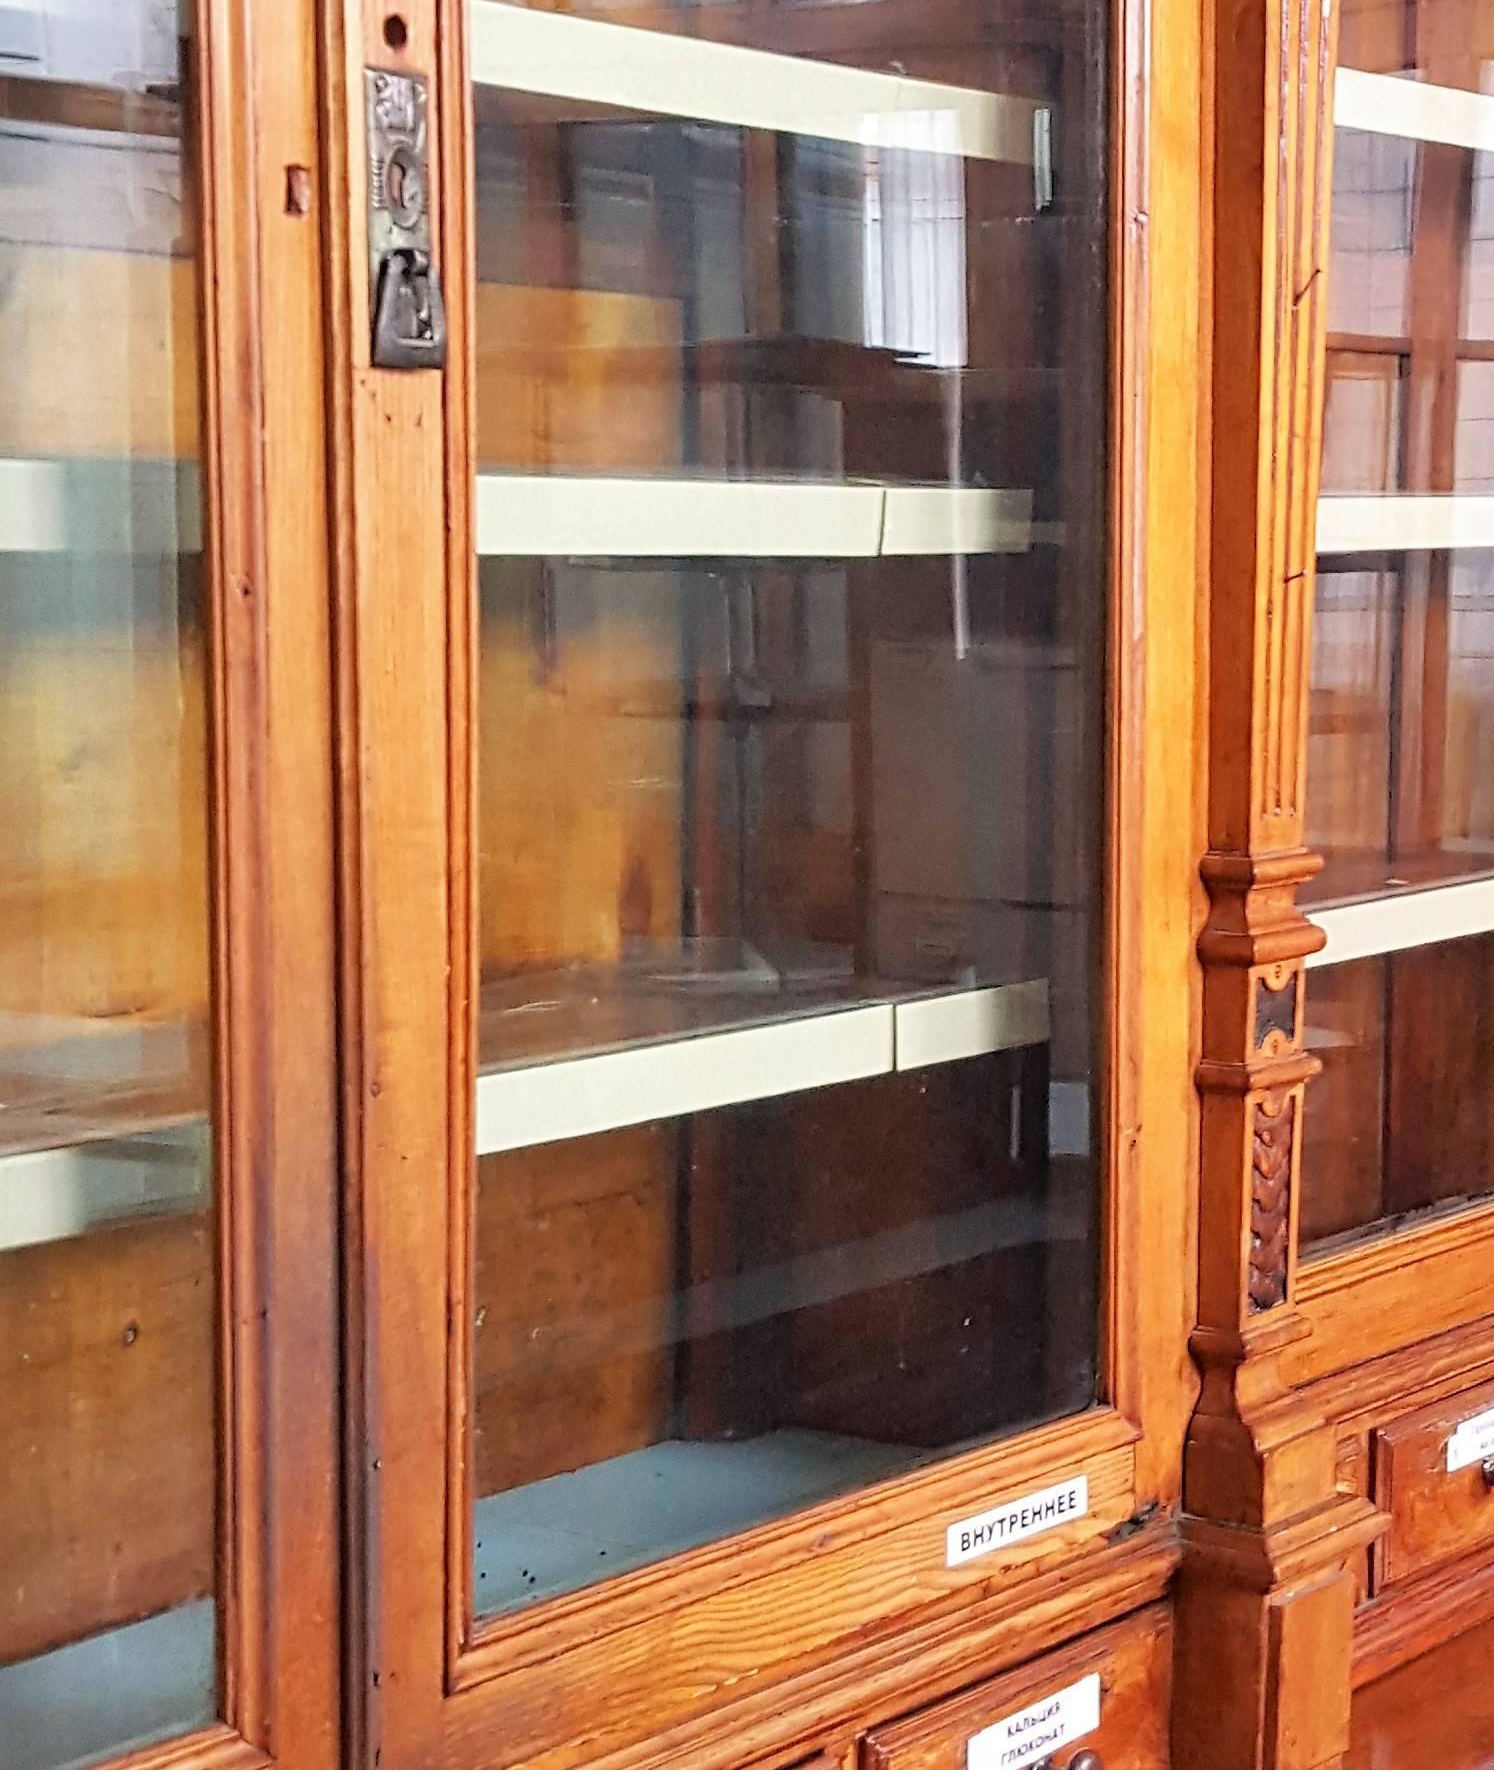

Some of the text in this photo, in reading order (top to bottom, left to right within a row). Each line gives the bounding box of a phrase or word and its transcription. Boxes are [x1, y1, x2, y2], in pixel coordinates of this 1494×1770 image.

[960, 1490, 1078, 1553] ВНУТРЕННЕЕ
[1006, 1701, 1061, 1739] КАЛЬЦИЯ
[1000, 1722, 1066, 1767] ГЛЮКОНАТ
